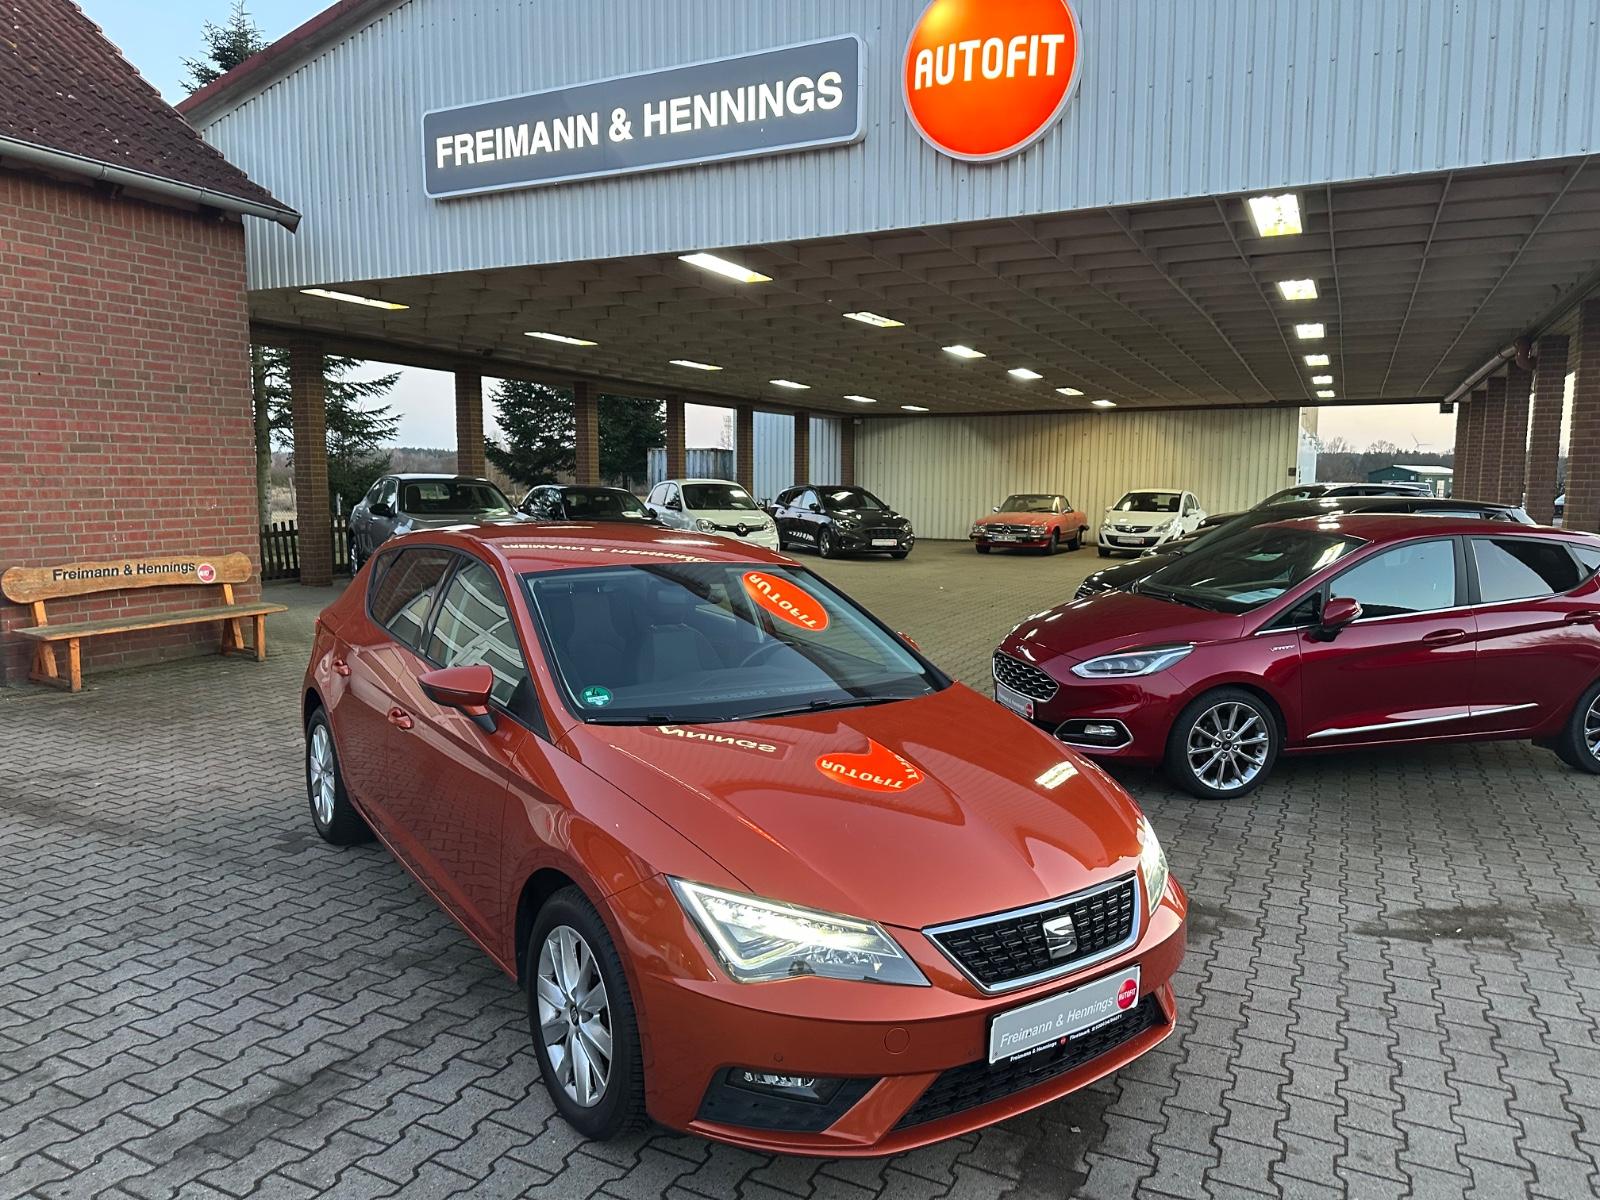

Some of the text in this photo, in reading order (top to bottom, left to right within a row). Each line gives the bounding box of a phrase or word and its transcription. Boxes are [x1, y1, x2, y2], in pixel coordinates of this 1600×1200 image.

[915, 32, 1066, 91] AUTOFIT
[435, 71, 844, 169] FREIMANN & HENNINGS
[52, 564, 120, 581] Freimann
[124, 564, 133, 576] &
[137, 561, 196, 576] Hennings
[1118, 988, 1136, 1001] AUTOFIT
[1000, 1020, 1053, 1048] Freimann
[1055, 1013, 1064, 1027] &
[1066, 996, 1114, 1023] Hennings
